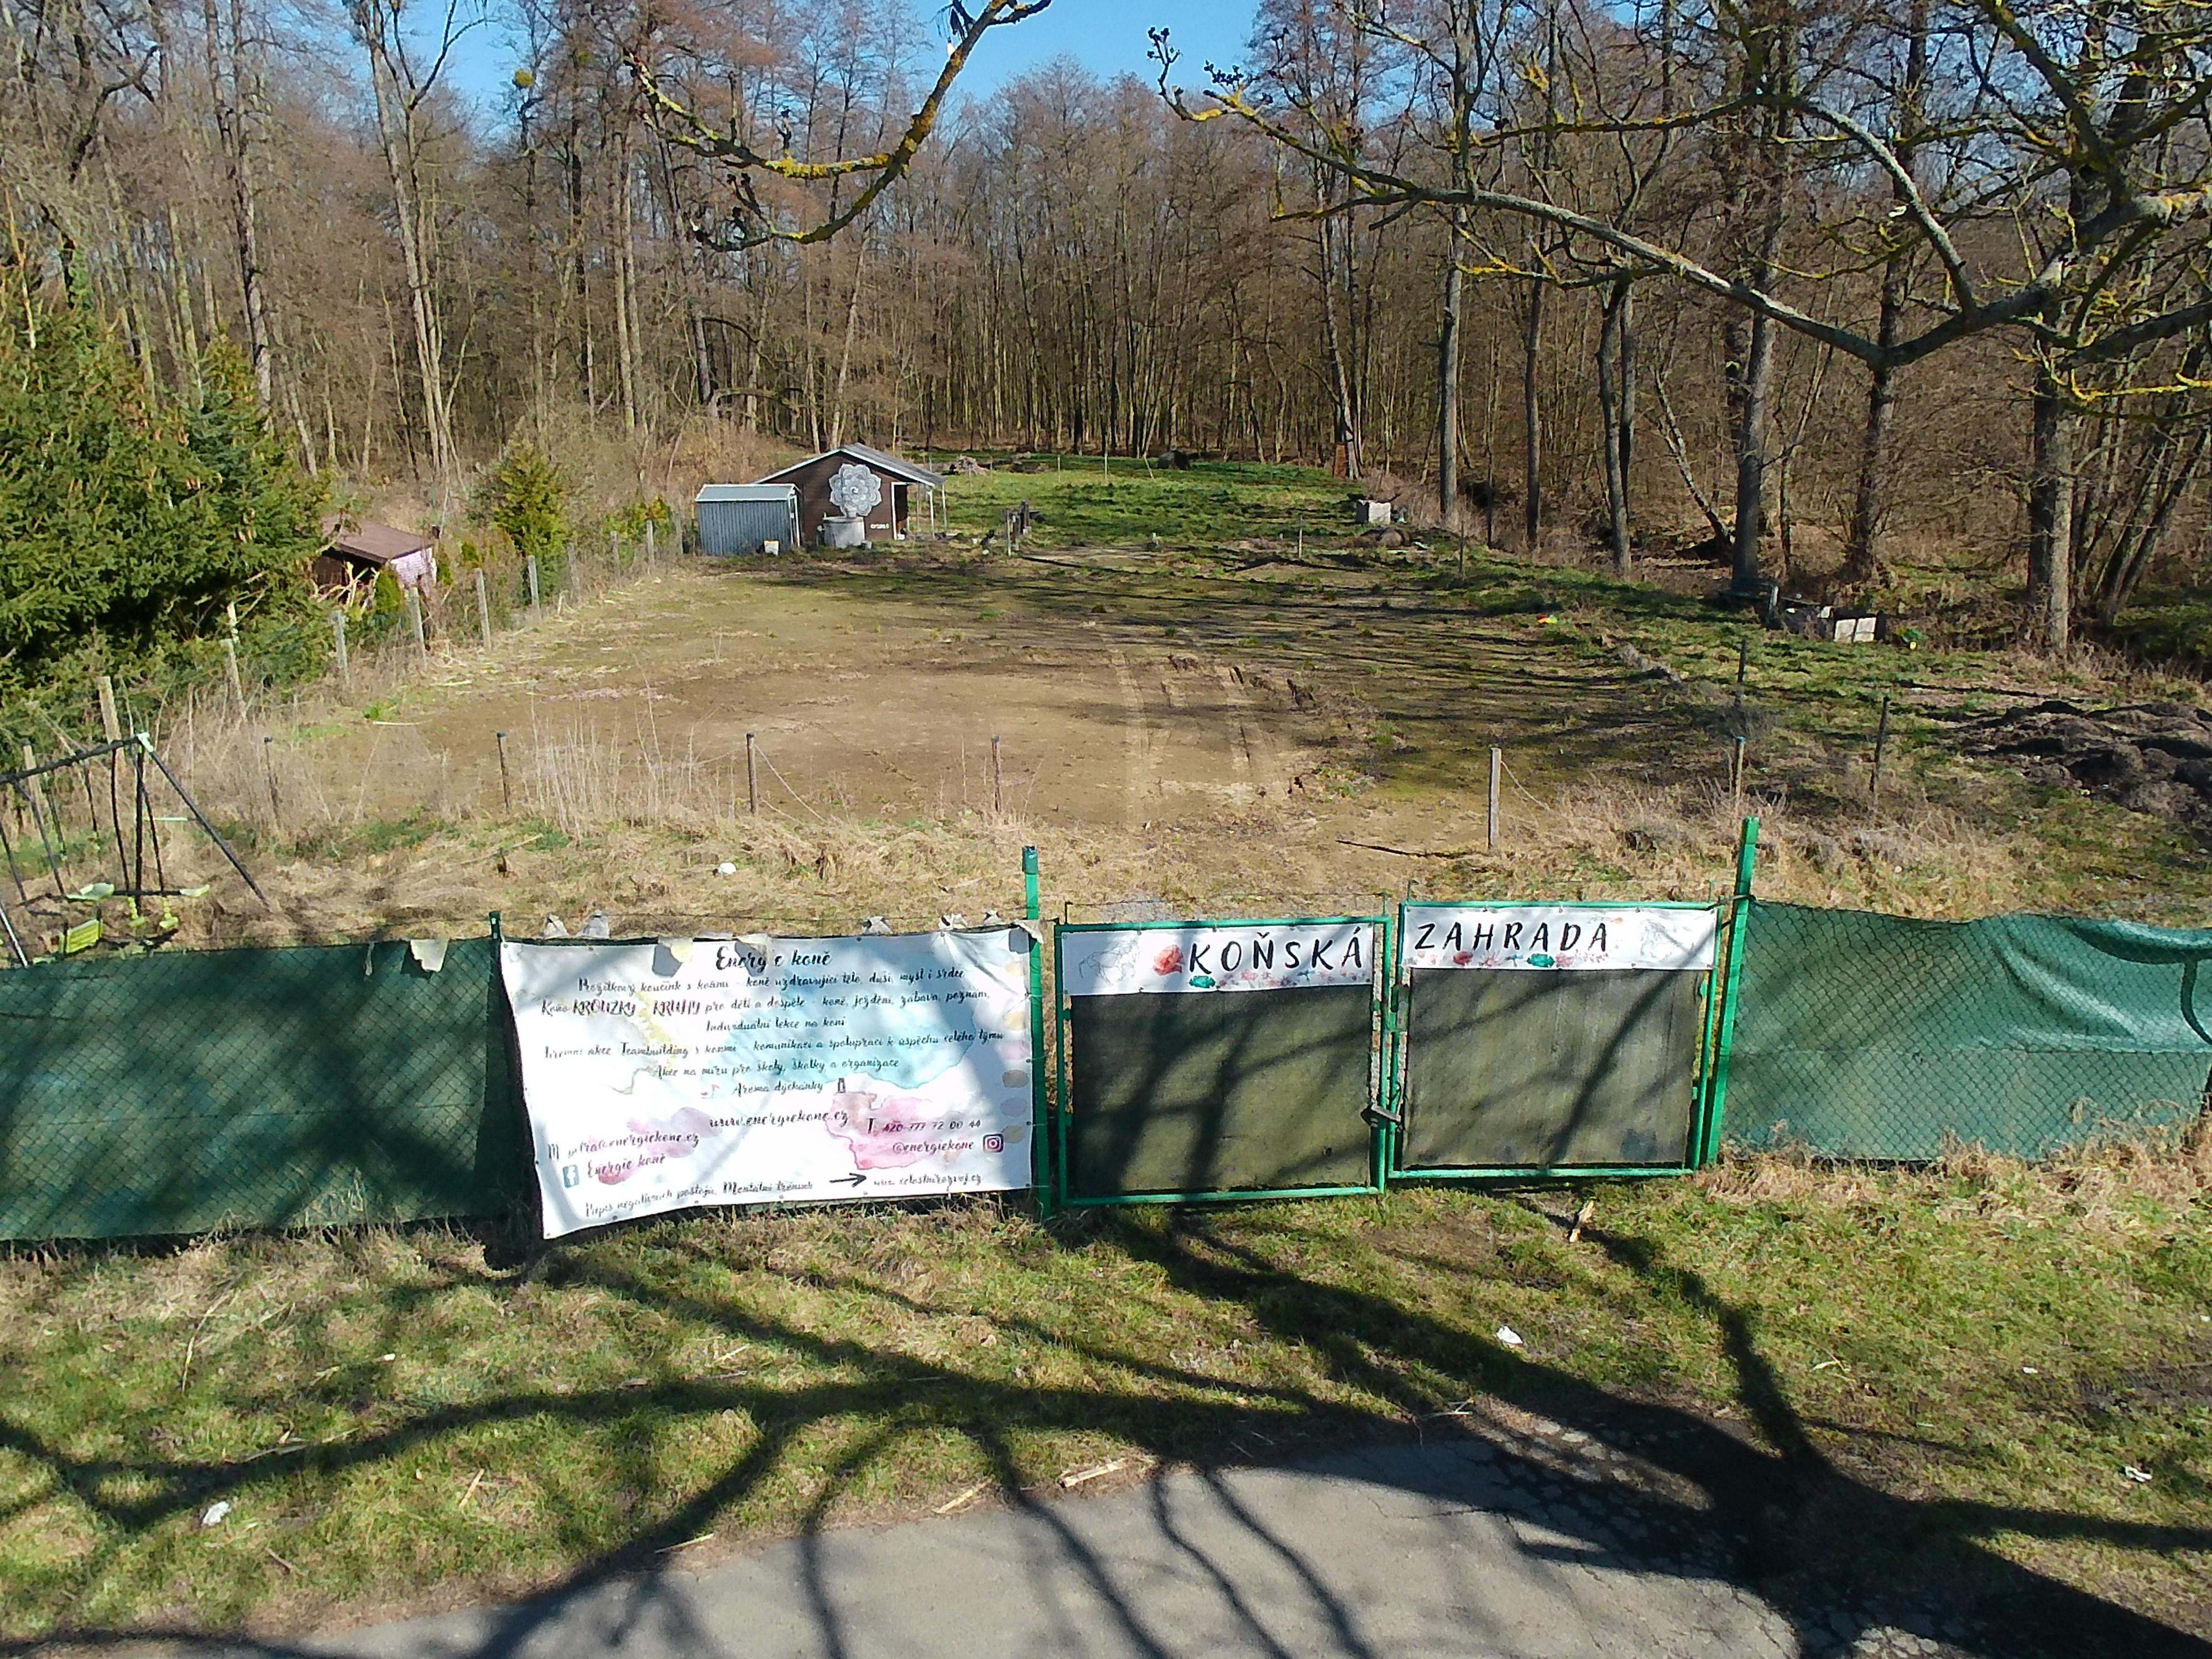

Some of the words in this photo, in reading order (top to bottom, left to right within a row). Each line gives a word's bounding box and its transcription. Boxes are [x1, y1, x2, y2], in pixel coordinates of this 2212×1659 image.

[1188, 926, 1363, 974] KOŇSKÁ
[1415, 922, 1606, 952] ZAHRADA
[716, 946, 783, 973] Energe
[791, 948, 832, 966] koně
